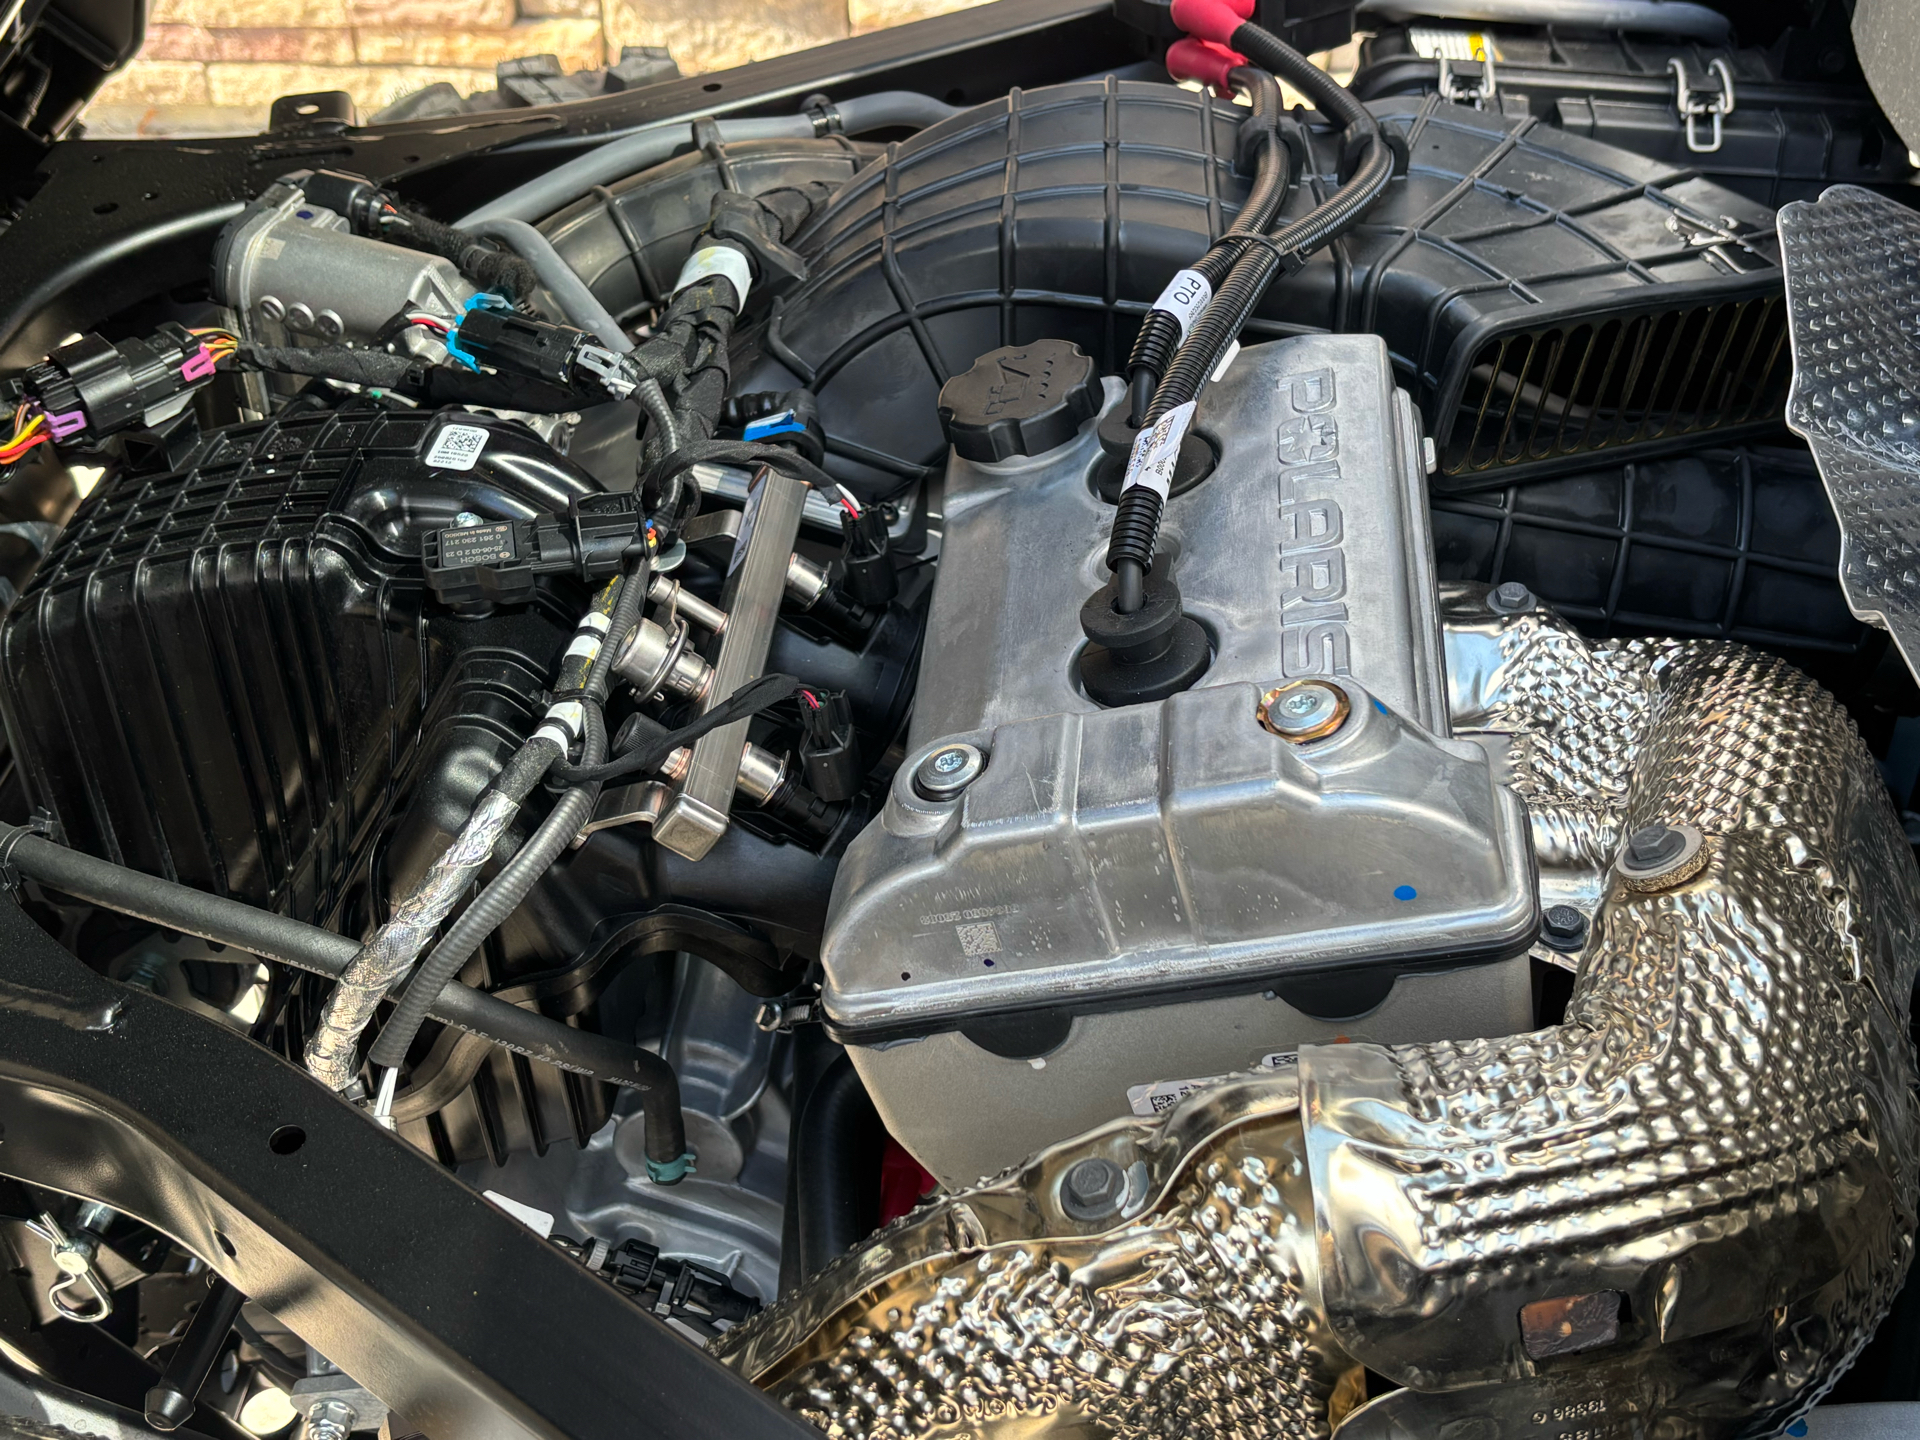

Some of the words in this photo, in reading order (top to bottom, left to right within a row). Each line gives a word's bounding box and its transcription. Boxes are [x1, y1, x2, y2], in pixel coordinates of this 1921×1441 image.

[1174, 277, 1202, 305] PTO
[1276, 367, 1351, 678] POLARIS
[445, 539, 460, 547] 217
[460, 553, 497, 564] BOSCH
